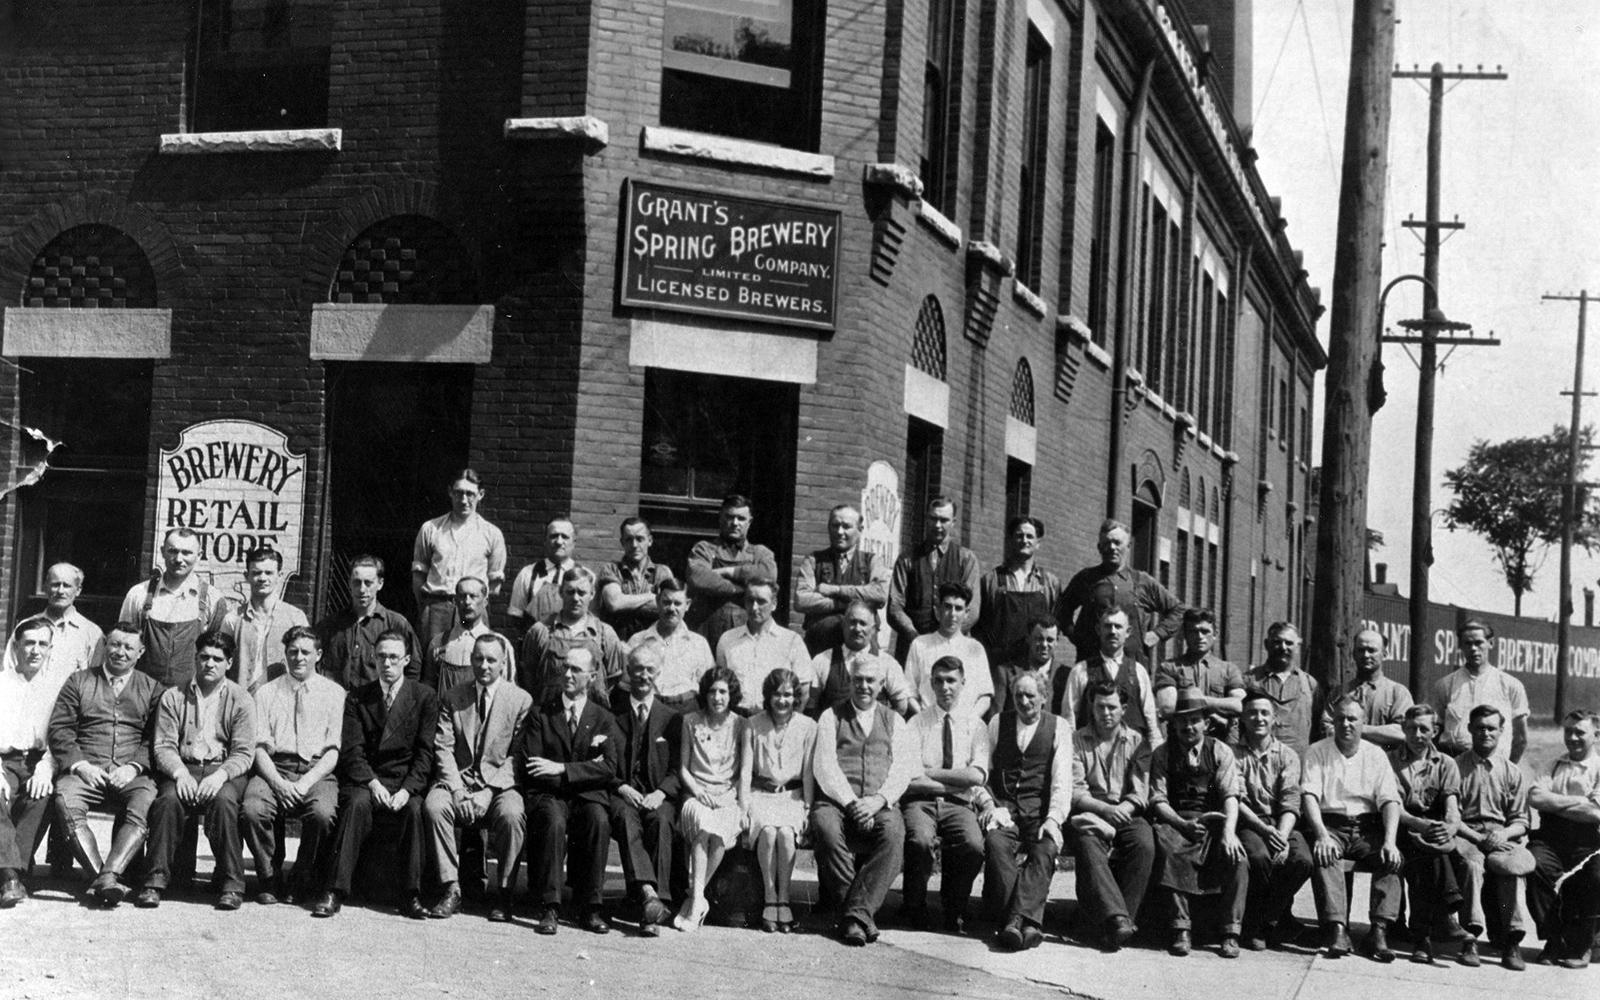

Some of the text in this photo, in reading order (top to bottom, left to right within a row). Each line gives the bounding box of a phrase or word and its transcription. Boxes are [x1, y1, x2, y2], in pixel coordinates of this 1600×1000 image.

[638, 192, 729, 225] GRANT'S
[634, 222, 832, 261] SPRING BREWERY
[702, 268, 762, 282] LIMITED
[755, 254, 831, 278] COMPANY.
[638, 275, 827, 314] LICENSED BREWERS.
[167, 441, 302, 495] BREWERY
[166, 498, 288, 531] RETAIL
[188, 531, 278, 563] TORE
[1497, 637, 1559, 674] BREWERY
